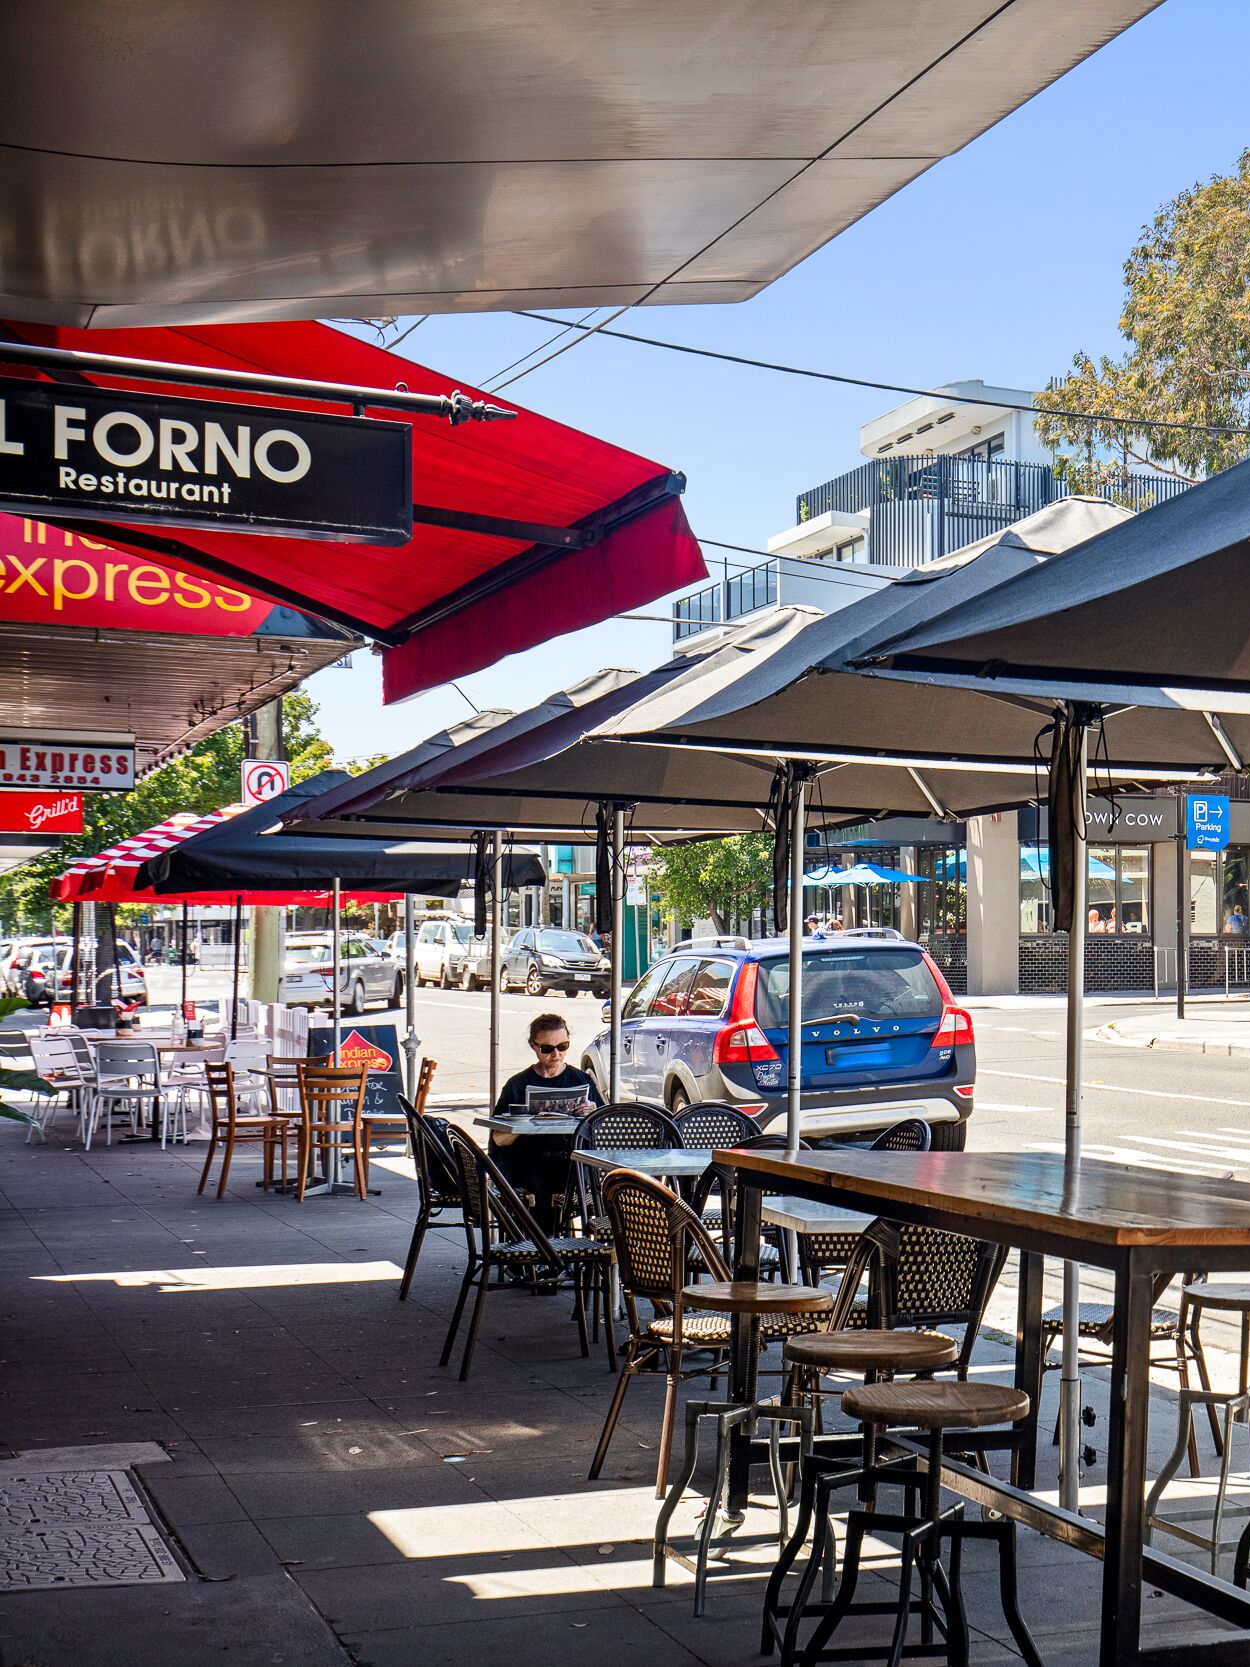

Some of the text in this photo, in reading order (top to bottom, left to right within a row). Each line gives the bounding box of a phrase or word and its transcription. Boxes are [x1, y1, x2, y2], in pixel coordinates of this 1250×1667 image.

[54, 405, 311, 483] FORNO
[59, 466, 231, 504] Restaurant
[0, 554, 252, 612] xpress
[20, 747, 129, 775] Express
[24, 796, 80, 829] Grill'd
[1084, 812, 1164, 827] OWN COW
[1195, 822, 1222, 833] Parking
[811, 1025, 900, 1037] VOLVO
[340, 1047, 376, 1059] indian
[331, 1058, 387, 1069] xpress
[755, 1063, 782, 1071] XC70
